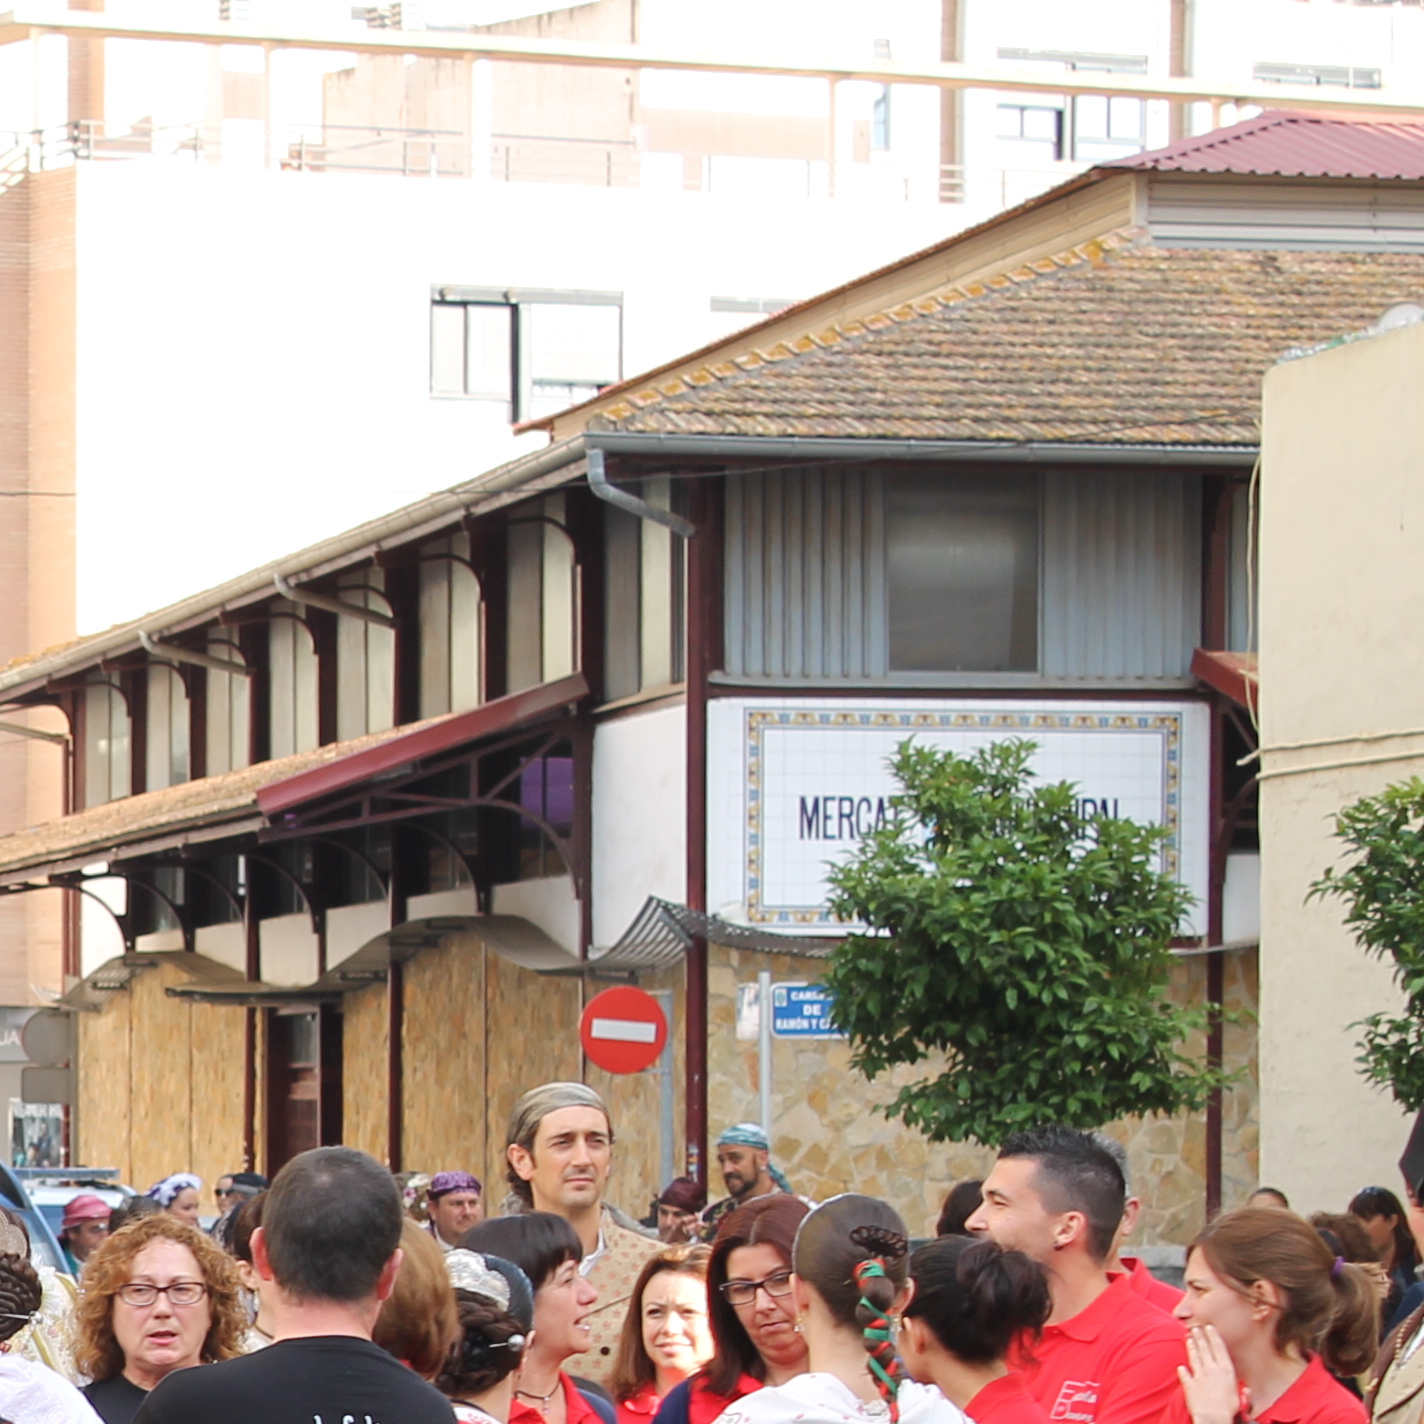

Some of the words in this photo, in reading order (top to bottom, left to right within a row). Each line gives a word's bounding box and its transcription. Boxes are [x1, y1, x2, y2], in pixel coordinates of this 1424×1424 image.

[803, 1004, 821, 1015] DE
[776, 1016, 809, 1029] RAMÓN
[811, 1019, 818, 1029] Y
